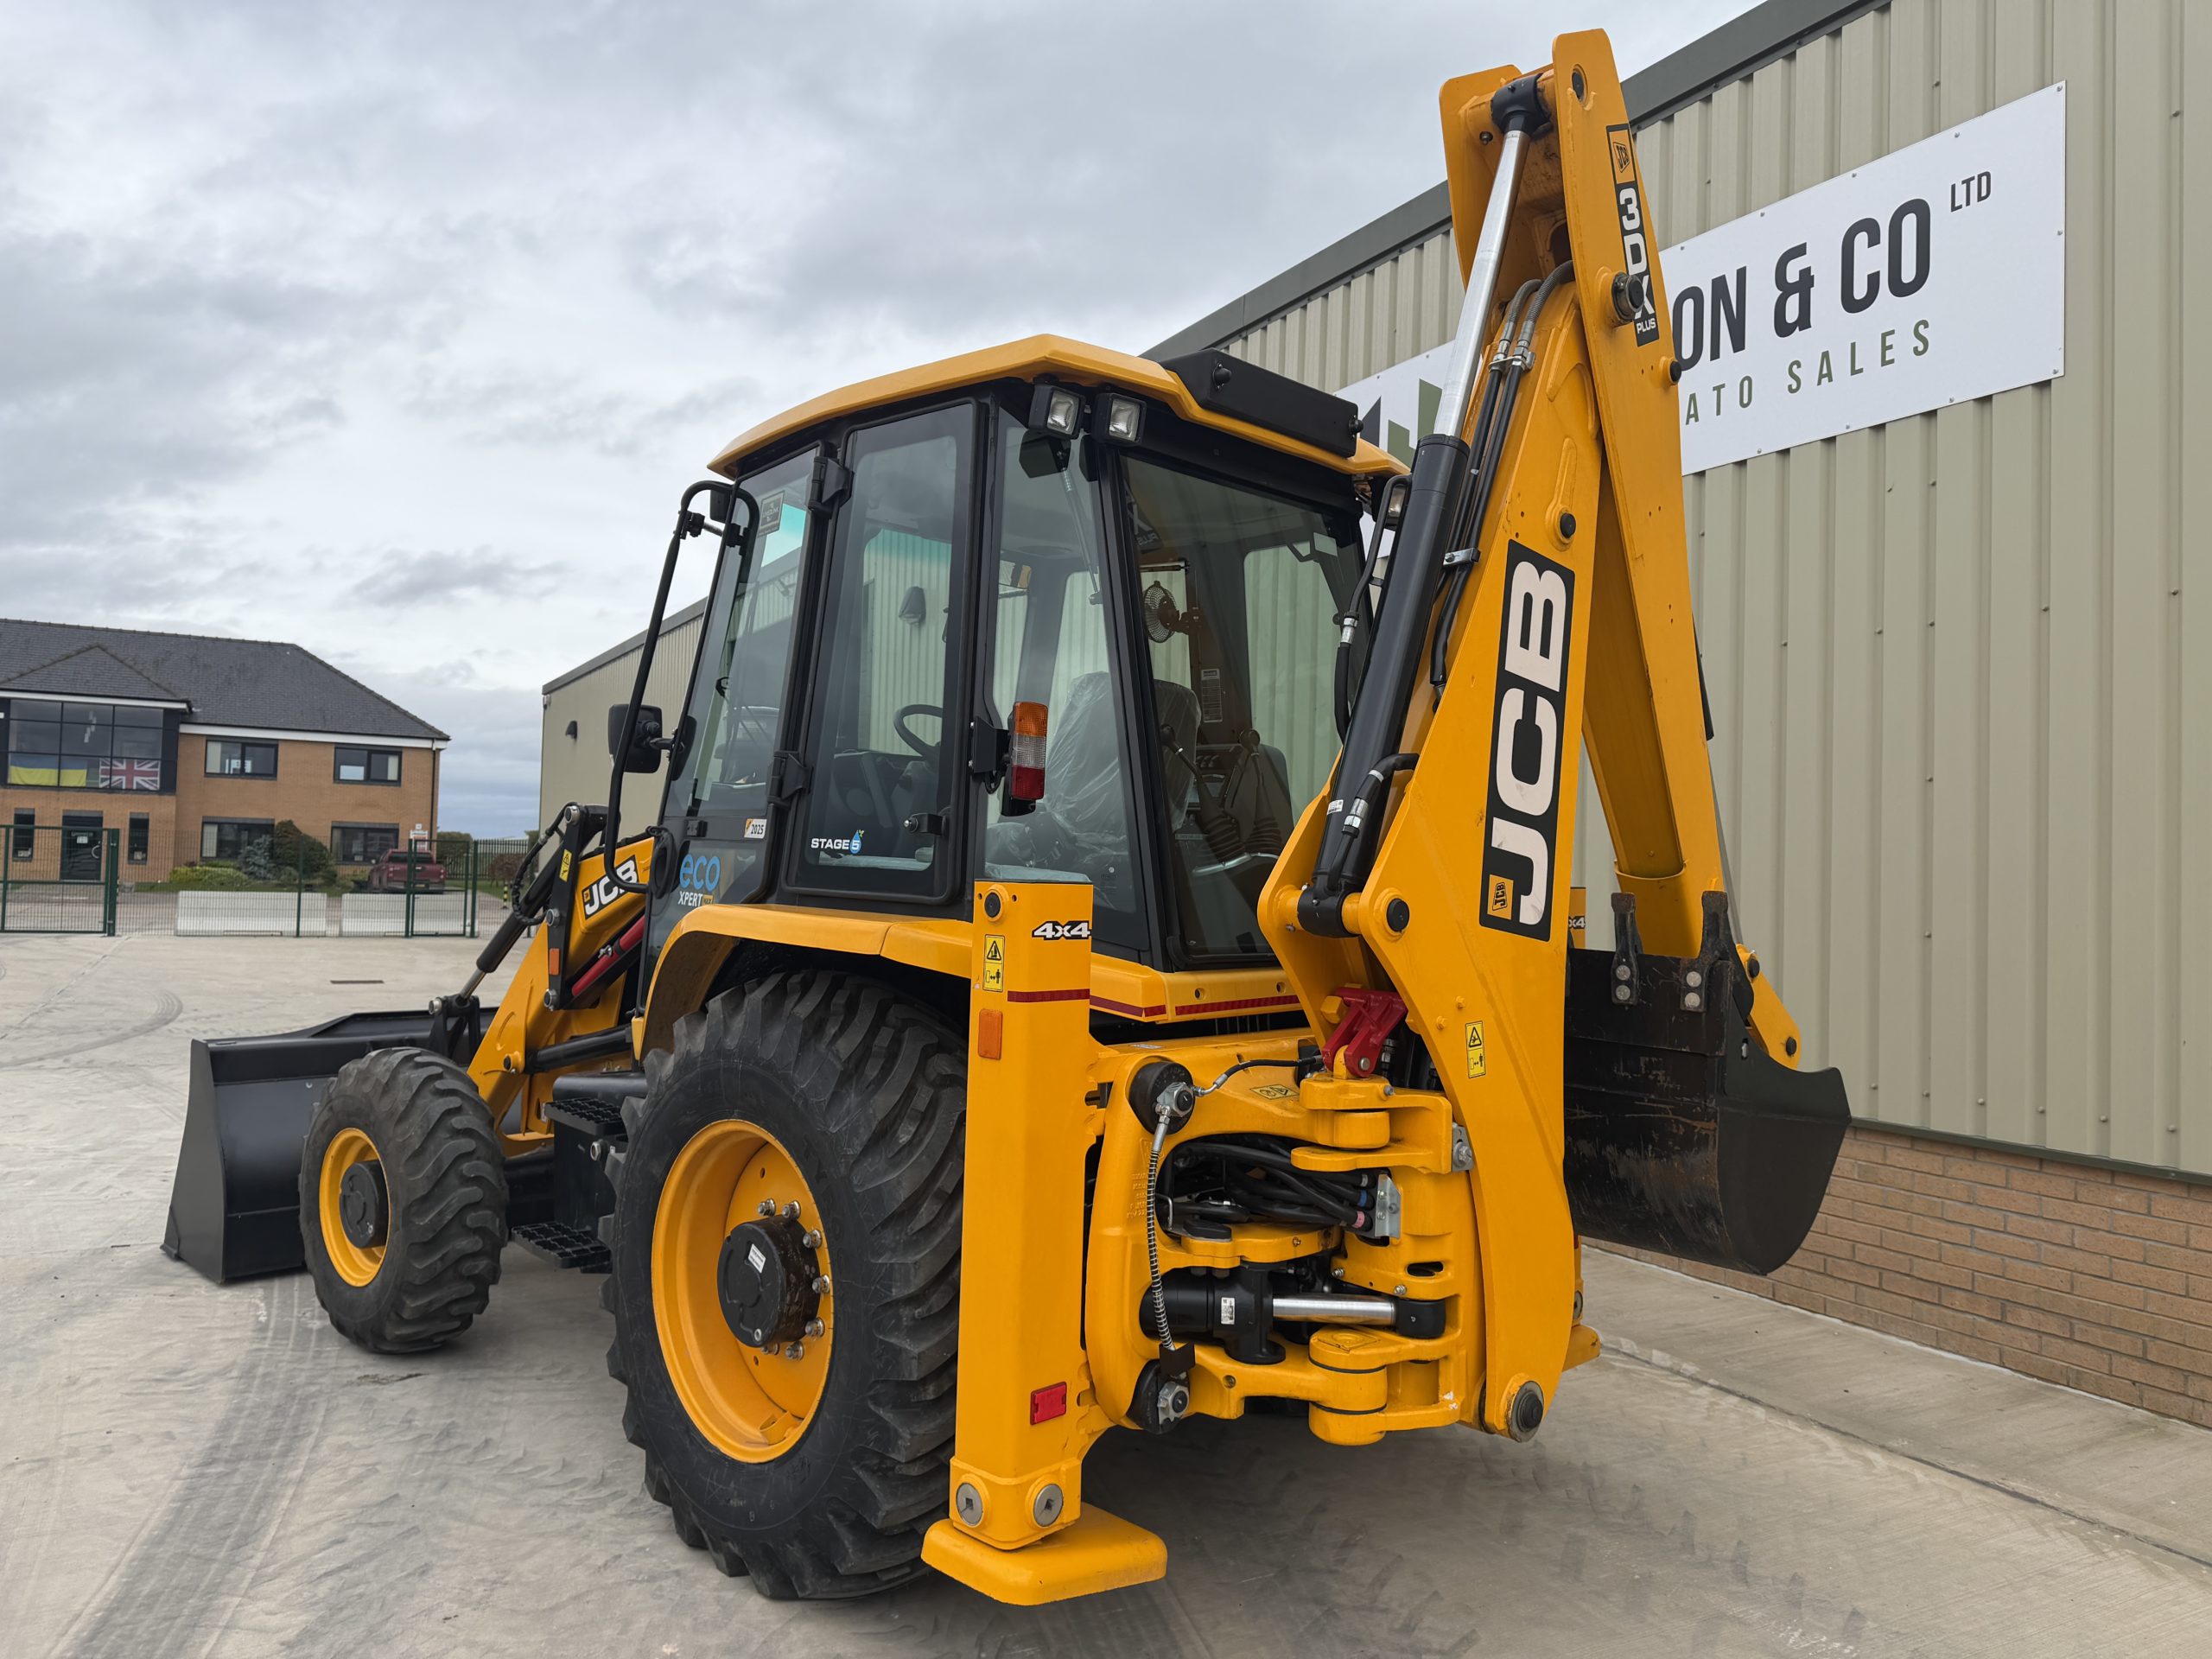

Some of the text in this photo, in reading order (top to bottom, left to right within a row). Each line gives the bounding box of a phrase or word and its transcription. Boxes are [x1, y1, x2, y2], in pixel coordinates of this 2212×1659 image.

[1774, 242, 1815, 338] &
[1840, 198, 1931, 314] CO
[1950, 171, 1992, 213] LTD
[1636, 318, 1656, 334] PLUS
[1685, 319, 1929, 425] ATO SALES
[1491, 561, 1567, 925] JCB
[751, 823, 764, 835] 2025
[811, 838, 850, 849] STAGE
[679, 853, 721, 893] eco
[585, 860, 638, 915] JCB
[677, 891, 703, 907] XPERT
[1494, 882, 1506, 906] JCB
[1033, 922, 1091, 938] 4x4
